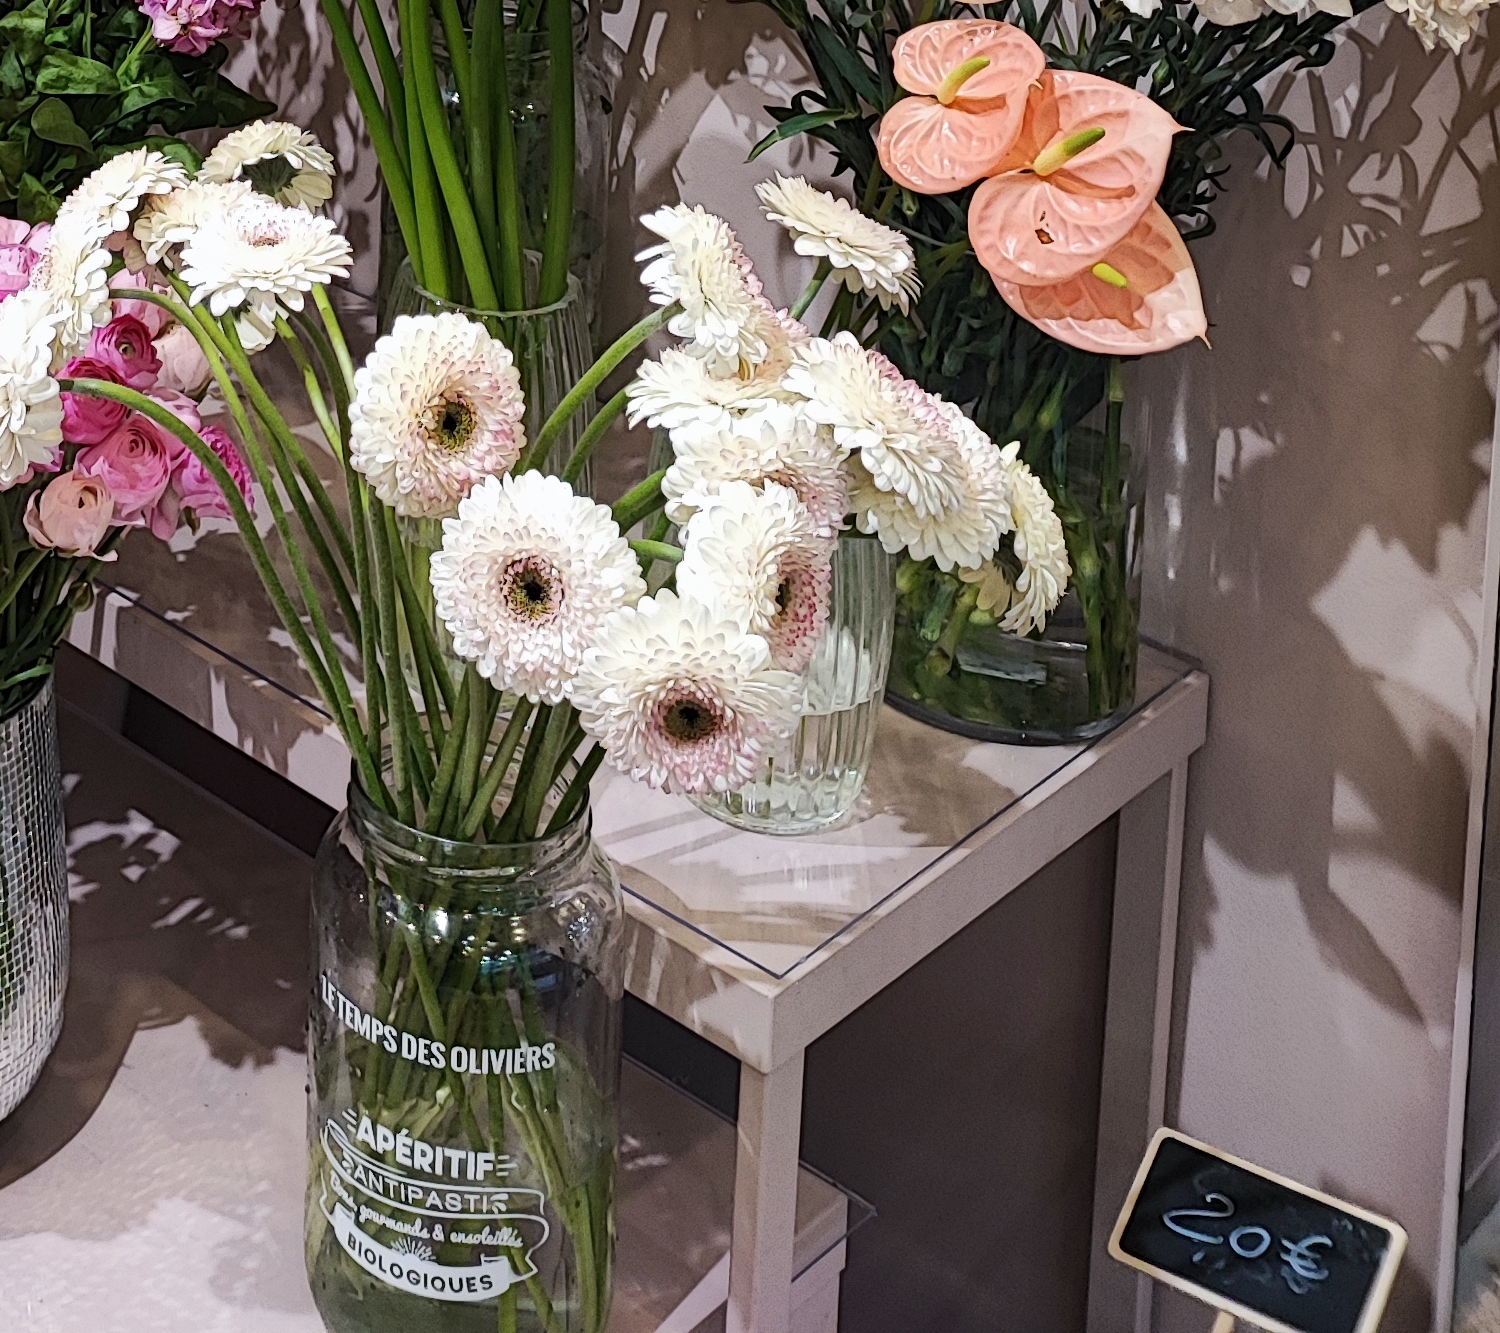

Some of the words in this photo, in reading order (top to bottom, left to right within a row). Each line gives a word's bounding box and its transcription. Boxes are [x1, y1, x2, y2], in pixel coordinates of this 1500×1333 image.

[321, 973, 337, 1013] LE
[336, 990, 398, 1054] TEMPS
[401, 1031, 446, 1069] DES
[450, 1042, 556, 1075] OLIVIERS
[355, 1114, 496, 1182] APÉRITIF
[353, 1164, 488, 1214] ANTIPASTI
[358, 1204, 431, 1241] gourmands
[432, 1223, 445, 1243] &
[1162, 1192, 1334, 1280] 20€
[346, 1230, 494, 1294] BIOLOGIQUES
